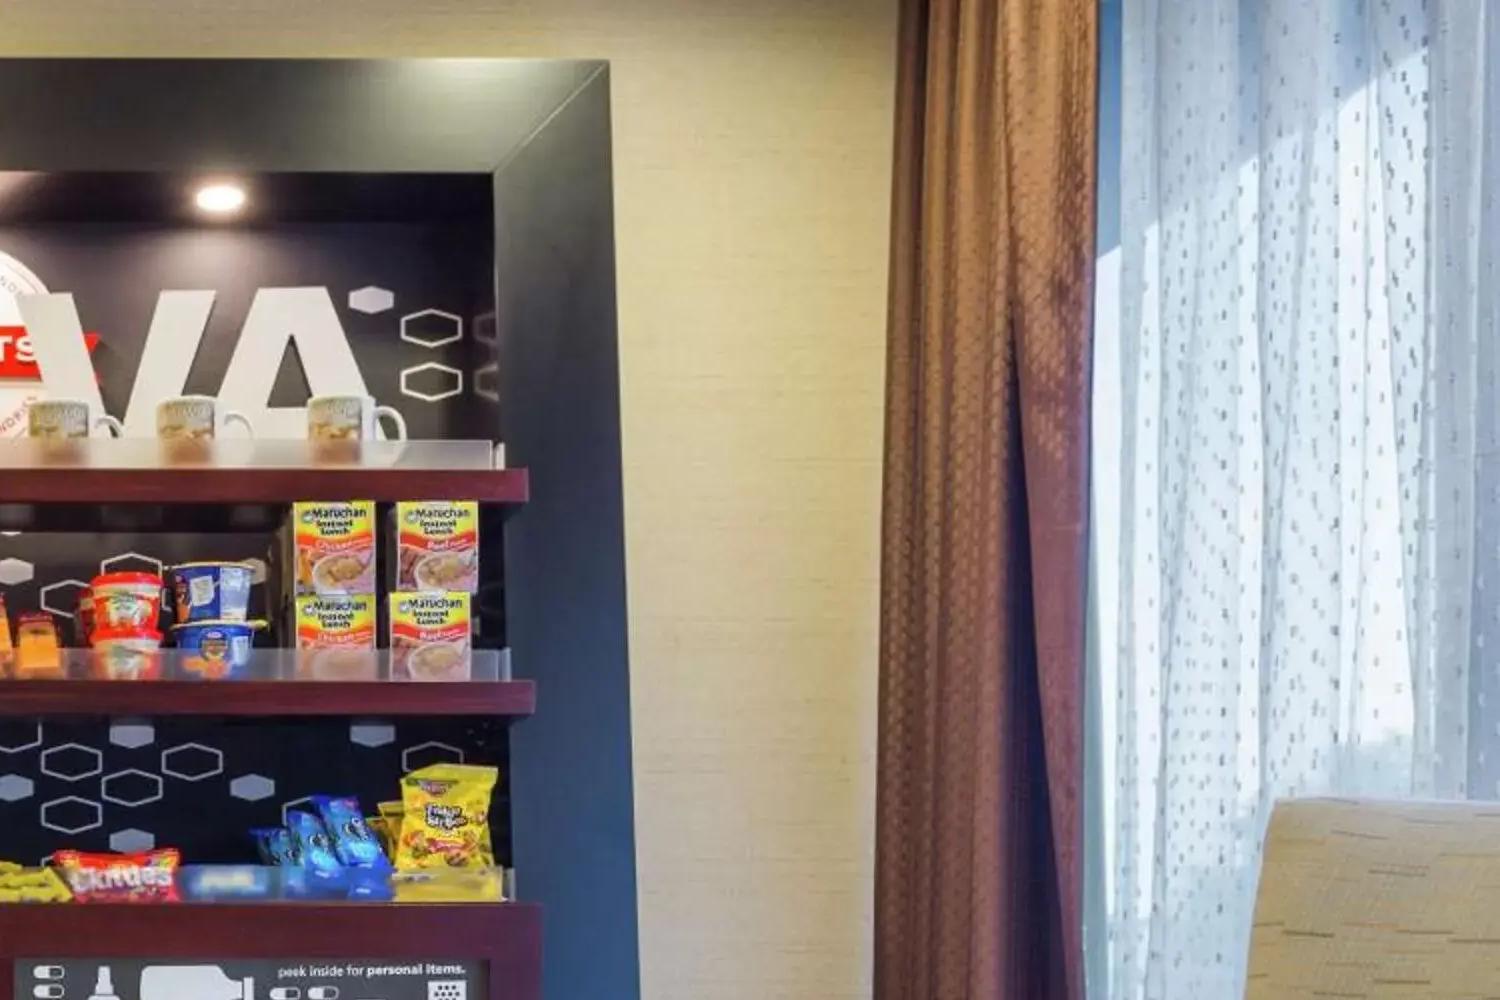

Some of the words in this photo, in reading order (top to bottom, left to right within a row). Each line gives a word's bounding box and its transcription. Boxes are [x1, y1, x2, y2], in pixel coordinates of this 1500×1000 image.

[313, 507, 366, 518] Maruchan
[417, 508, 470, 519] Maruchan
[313, 601, 367, 612] Maruchan
[408, 599, 462, 609] Maruchan
[277, 966, 306, 979] peek
[309, 965, 344, 977] inside
[347, 964, 364, 976] for
[367, 963, 423, 979] personal
[426, 963, 466, 975] items.
